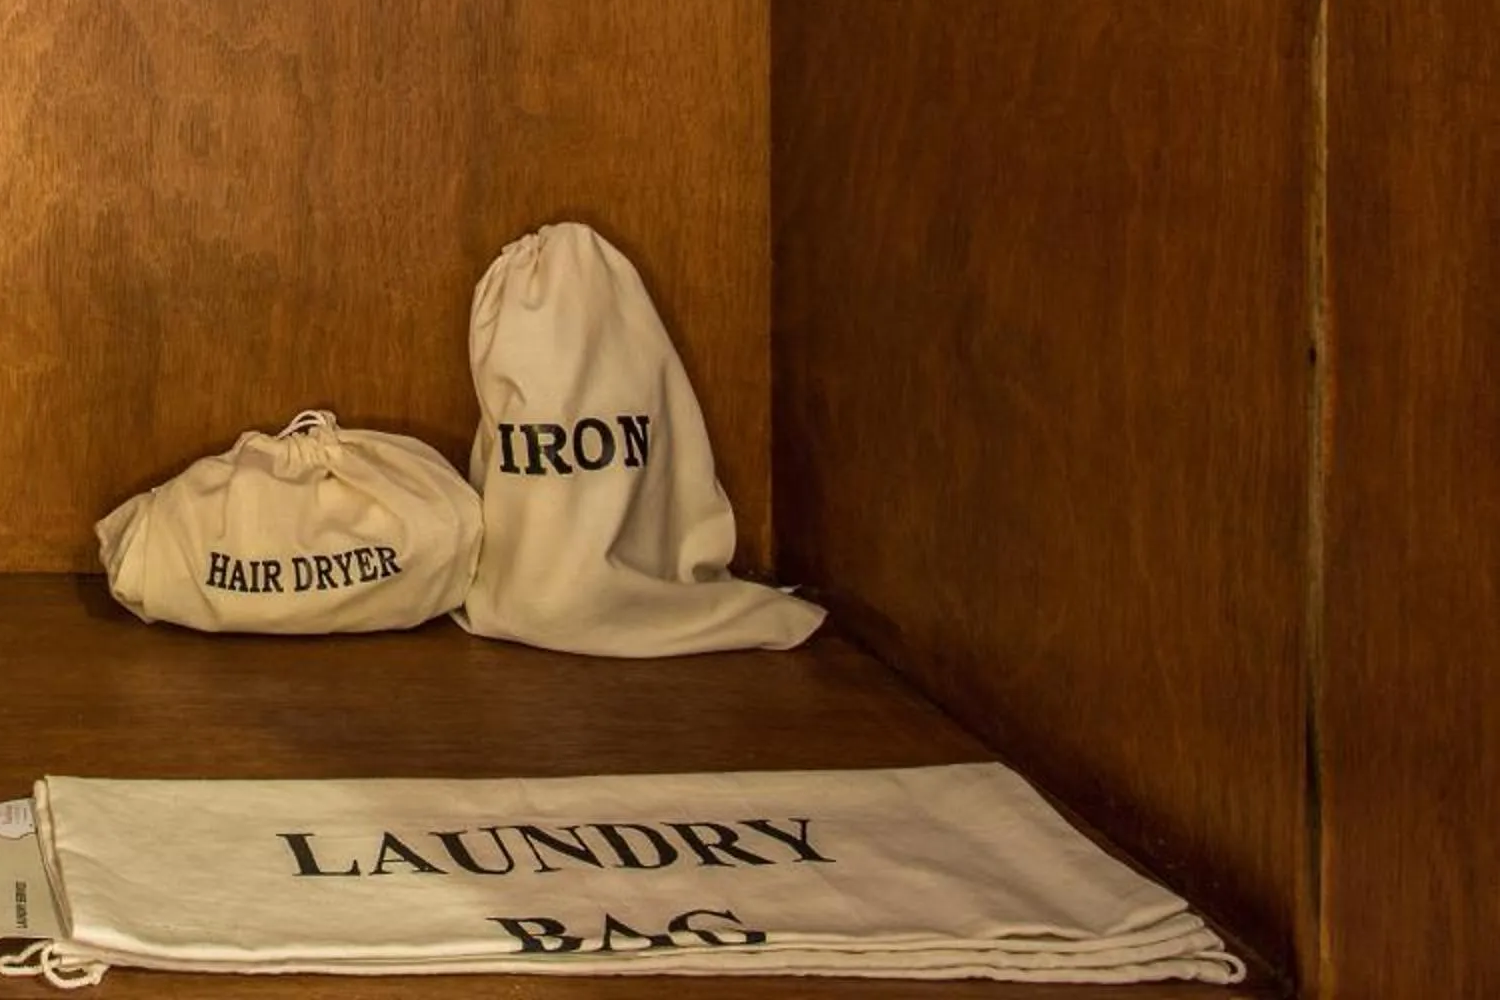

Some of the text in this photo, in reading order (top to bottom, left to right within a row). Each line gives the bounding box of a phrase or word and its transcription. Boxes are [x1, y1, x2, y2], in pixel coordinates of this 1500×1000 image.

[498, 415, 651, 476] IRON
[205, 545, 403, 594] HAIR DRYER
[276, 817, 837, 877] LAUNDRY
[485, 908, 767, 954] BAG
